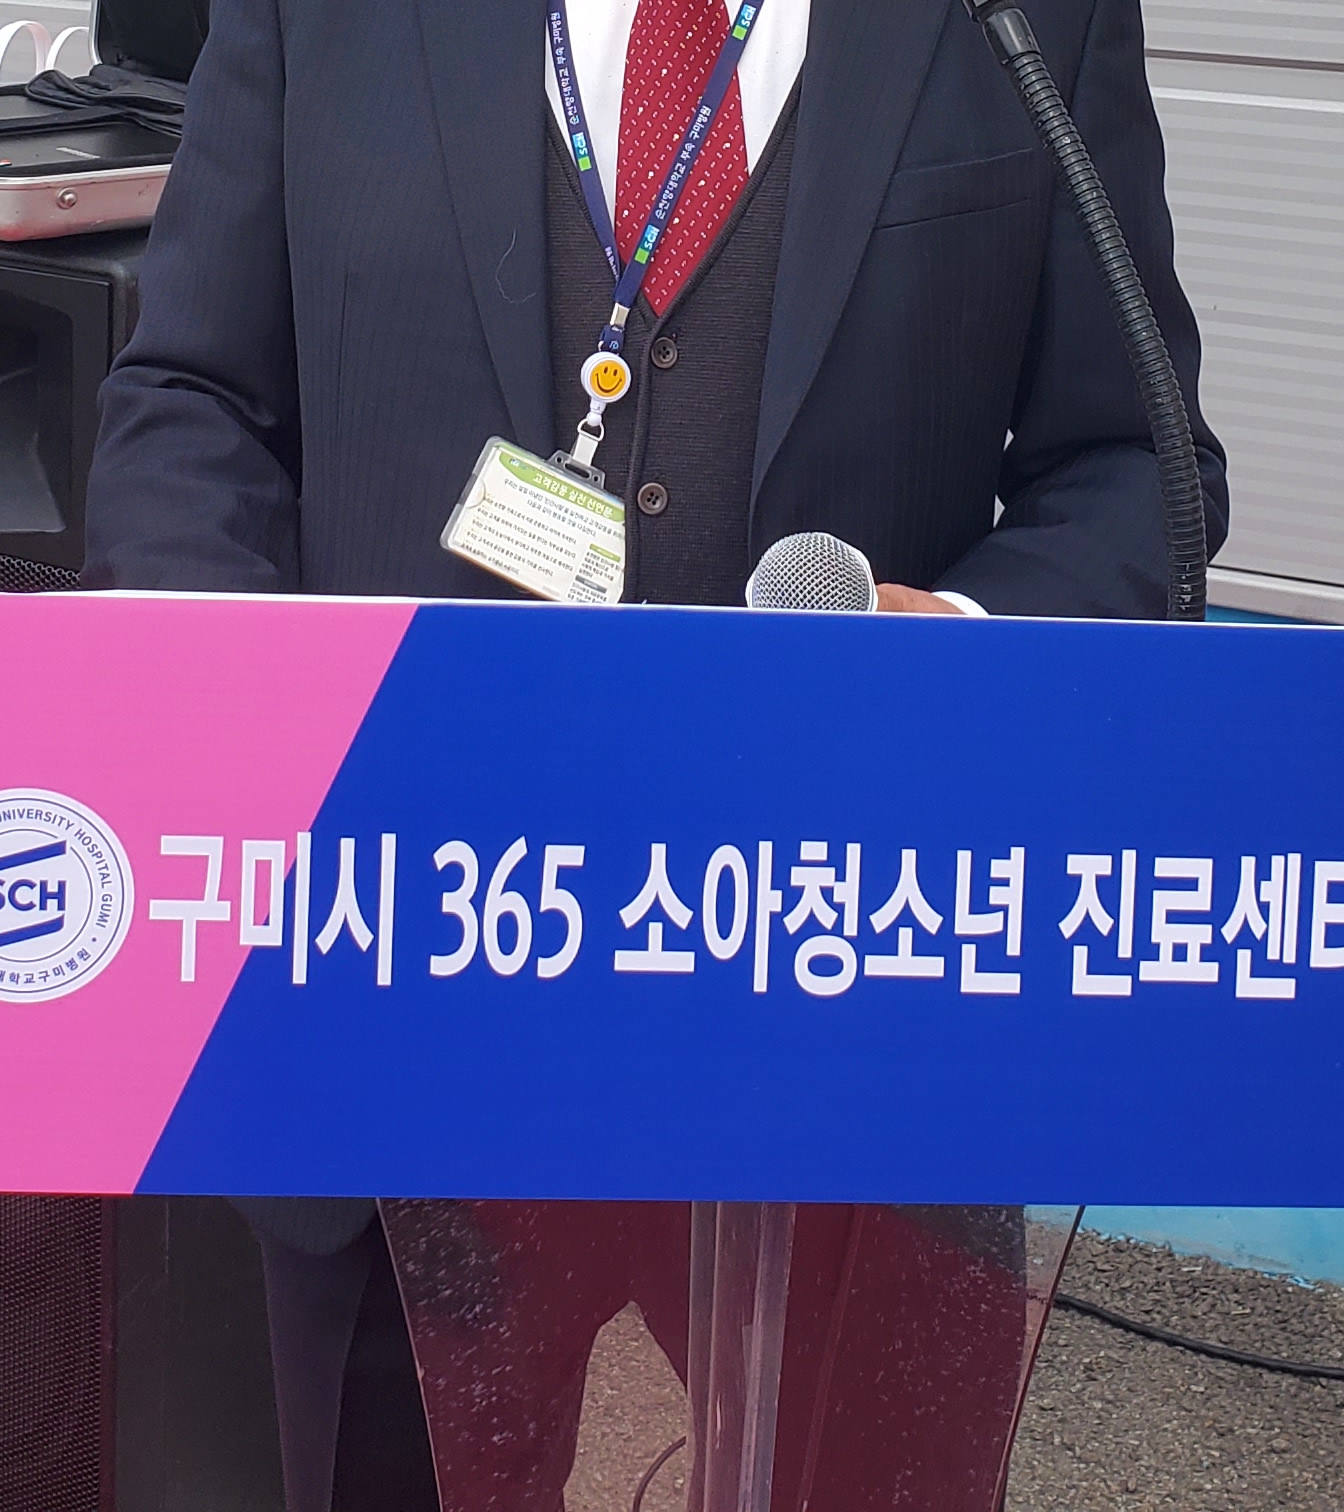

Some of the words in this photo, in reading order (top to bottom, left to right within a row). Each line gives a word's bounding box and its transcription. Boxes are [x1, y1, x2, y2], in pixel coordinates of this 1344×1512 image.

[533, 473, 568, 497] 고객감동
[74, 828, 113, 889] HOSPITAL
[95, 893, 113, 929] GUMI
[149, 831, 397, 986] 구미시
[429, 835, 586, 978] 365
[613, 840, 1026, 996] 소아청소년
